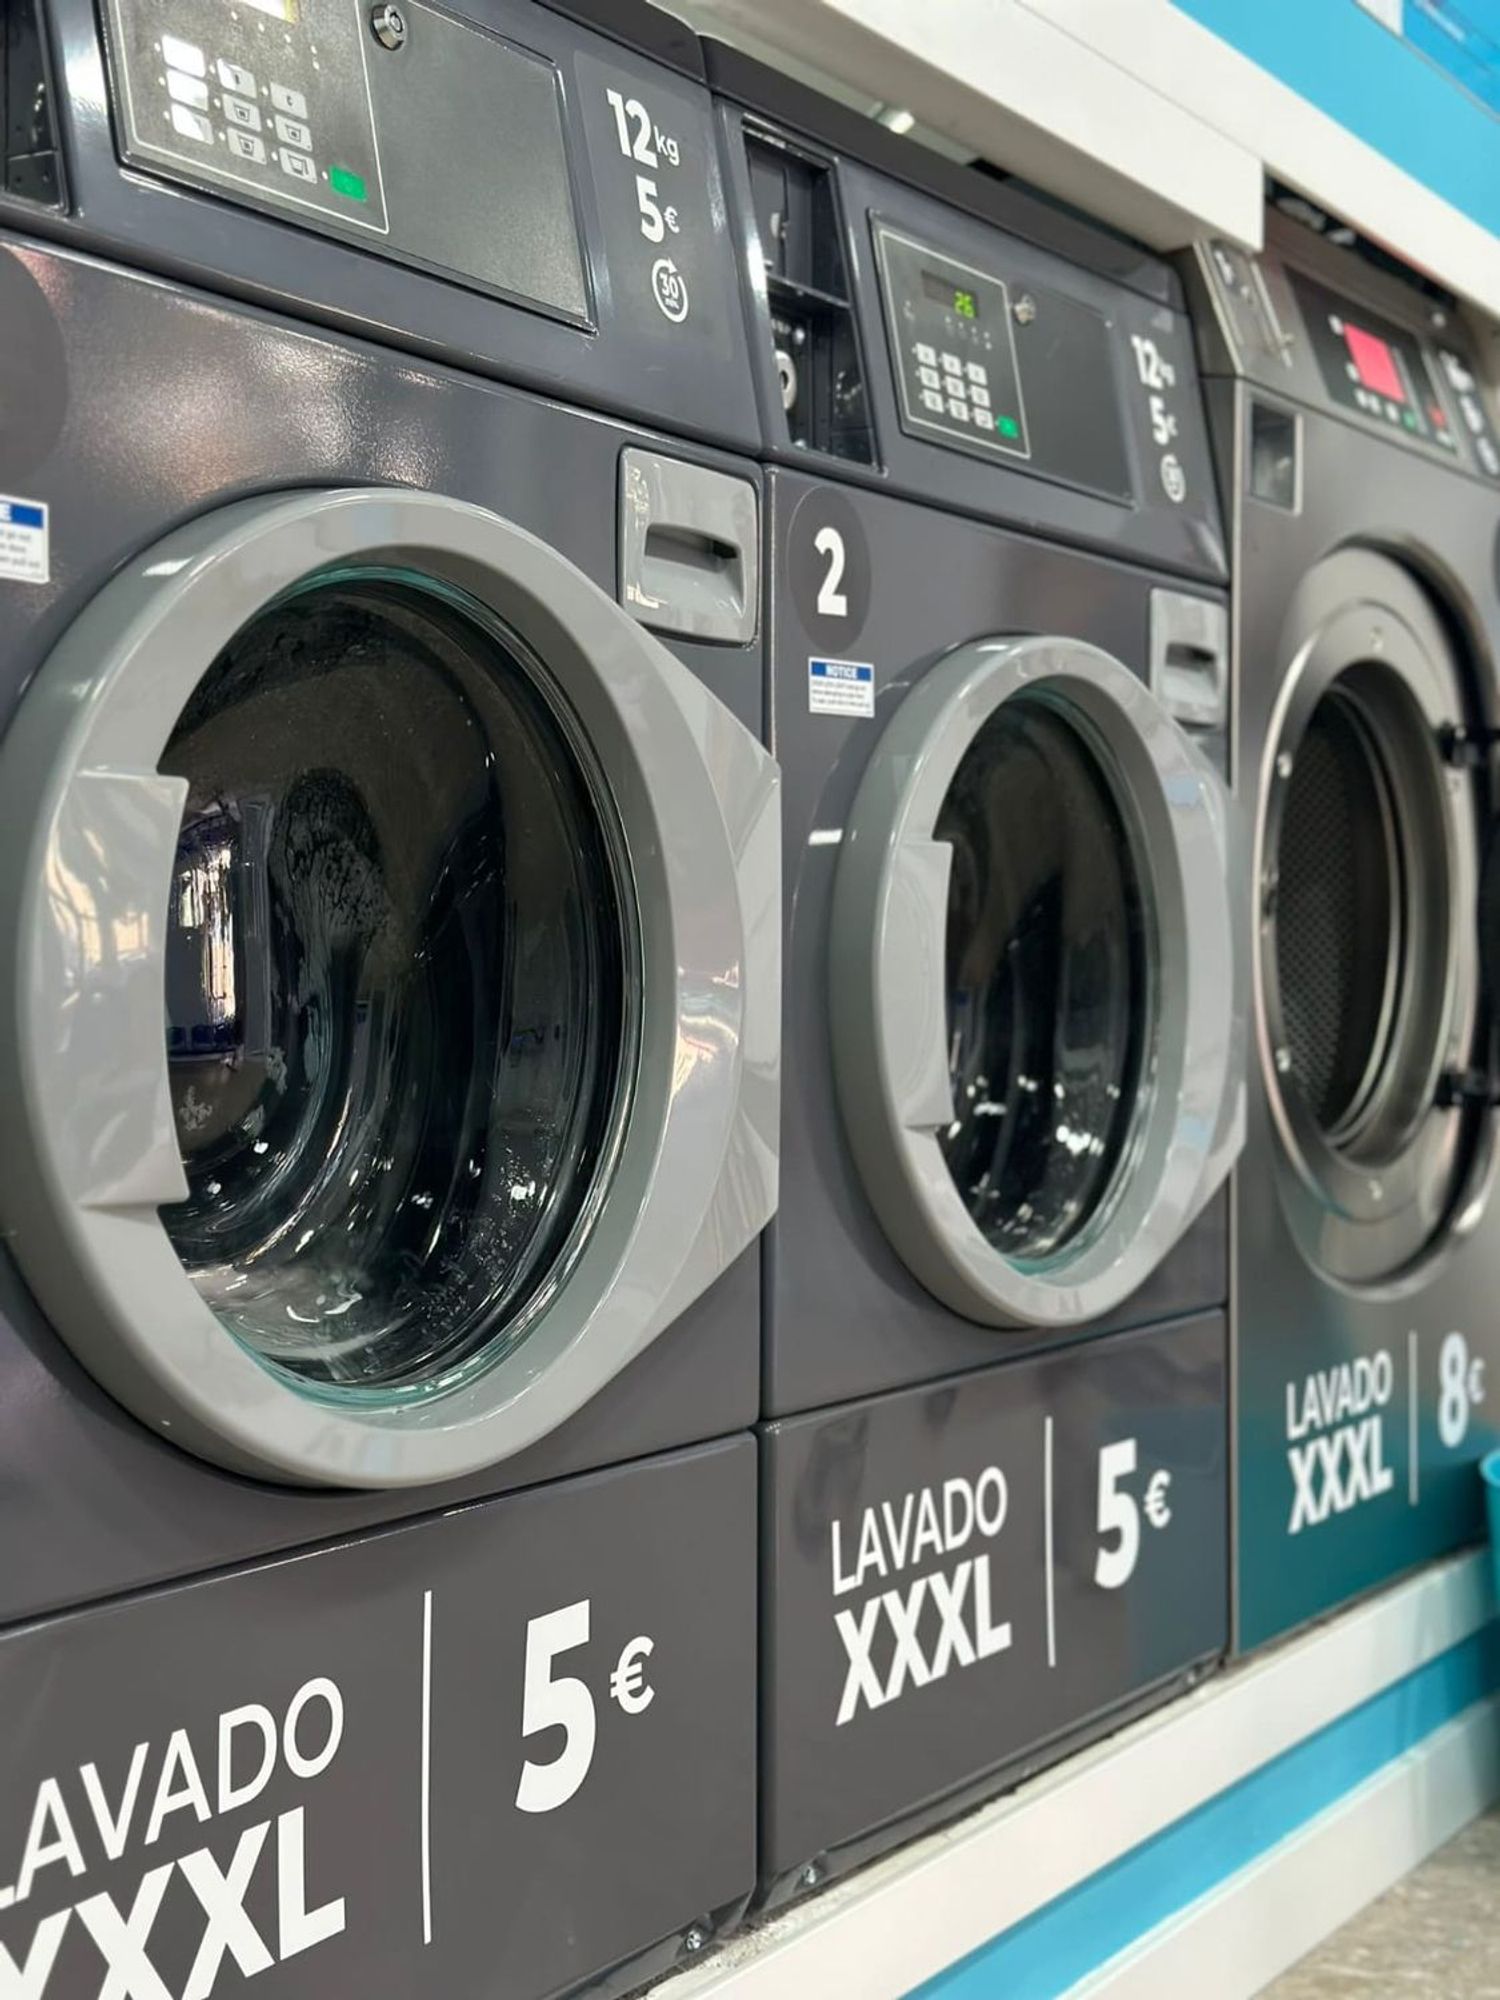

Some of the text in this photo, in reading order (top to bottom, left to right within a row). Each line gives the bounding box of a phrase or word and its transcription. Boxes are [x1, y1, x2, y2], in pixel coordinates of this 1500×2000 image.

[814, 527, 847, 617] 2
[1286, 1349, 1394, 1442] LAVADO
[832, 1466, 1008, 1596] LAVADO
[1095, 1438, 1172, 1589] 5€
[1286, 1414, 1395, 1535] XXXL
[834, 1553, 1012, 1727] XXXL
[515, 1599, 655, 1813] 5€
